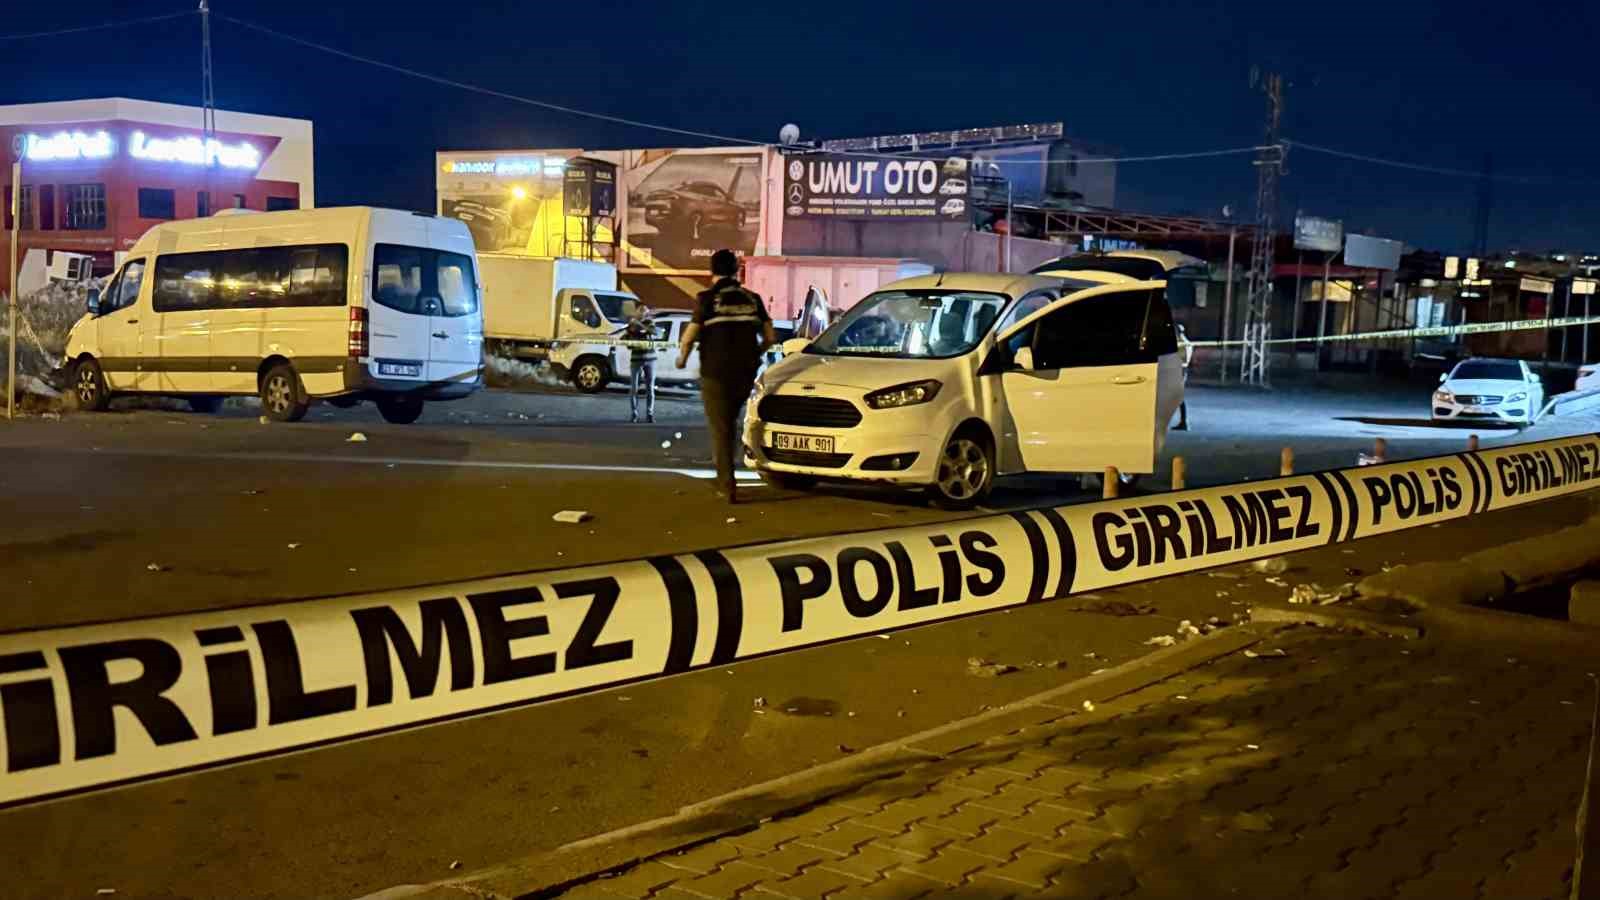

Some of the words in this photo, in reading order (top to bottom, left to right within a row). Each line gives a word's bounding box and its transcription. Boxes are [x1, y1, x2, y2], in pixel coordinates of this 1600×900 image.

[809, 160, 878, 194] UMUT
[884, 160, 938, 194] OTO
[778, 435, 789, 448] 09
[793, 437, 809, 449] AAK
[815, 438, 831, 451] 901
[1362, 466, 1463, 525] POLİS
[1093, 485, 1321, 571] GİRİLMEZ
[770, 530, 1006, 632] POLİS
